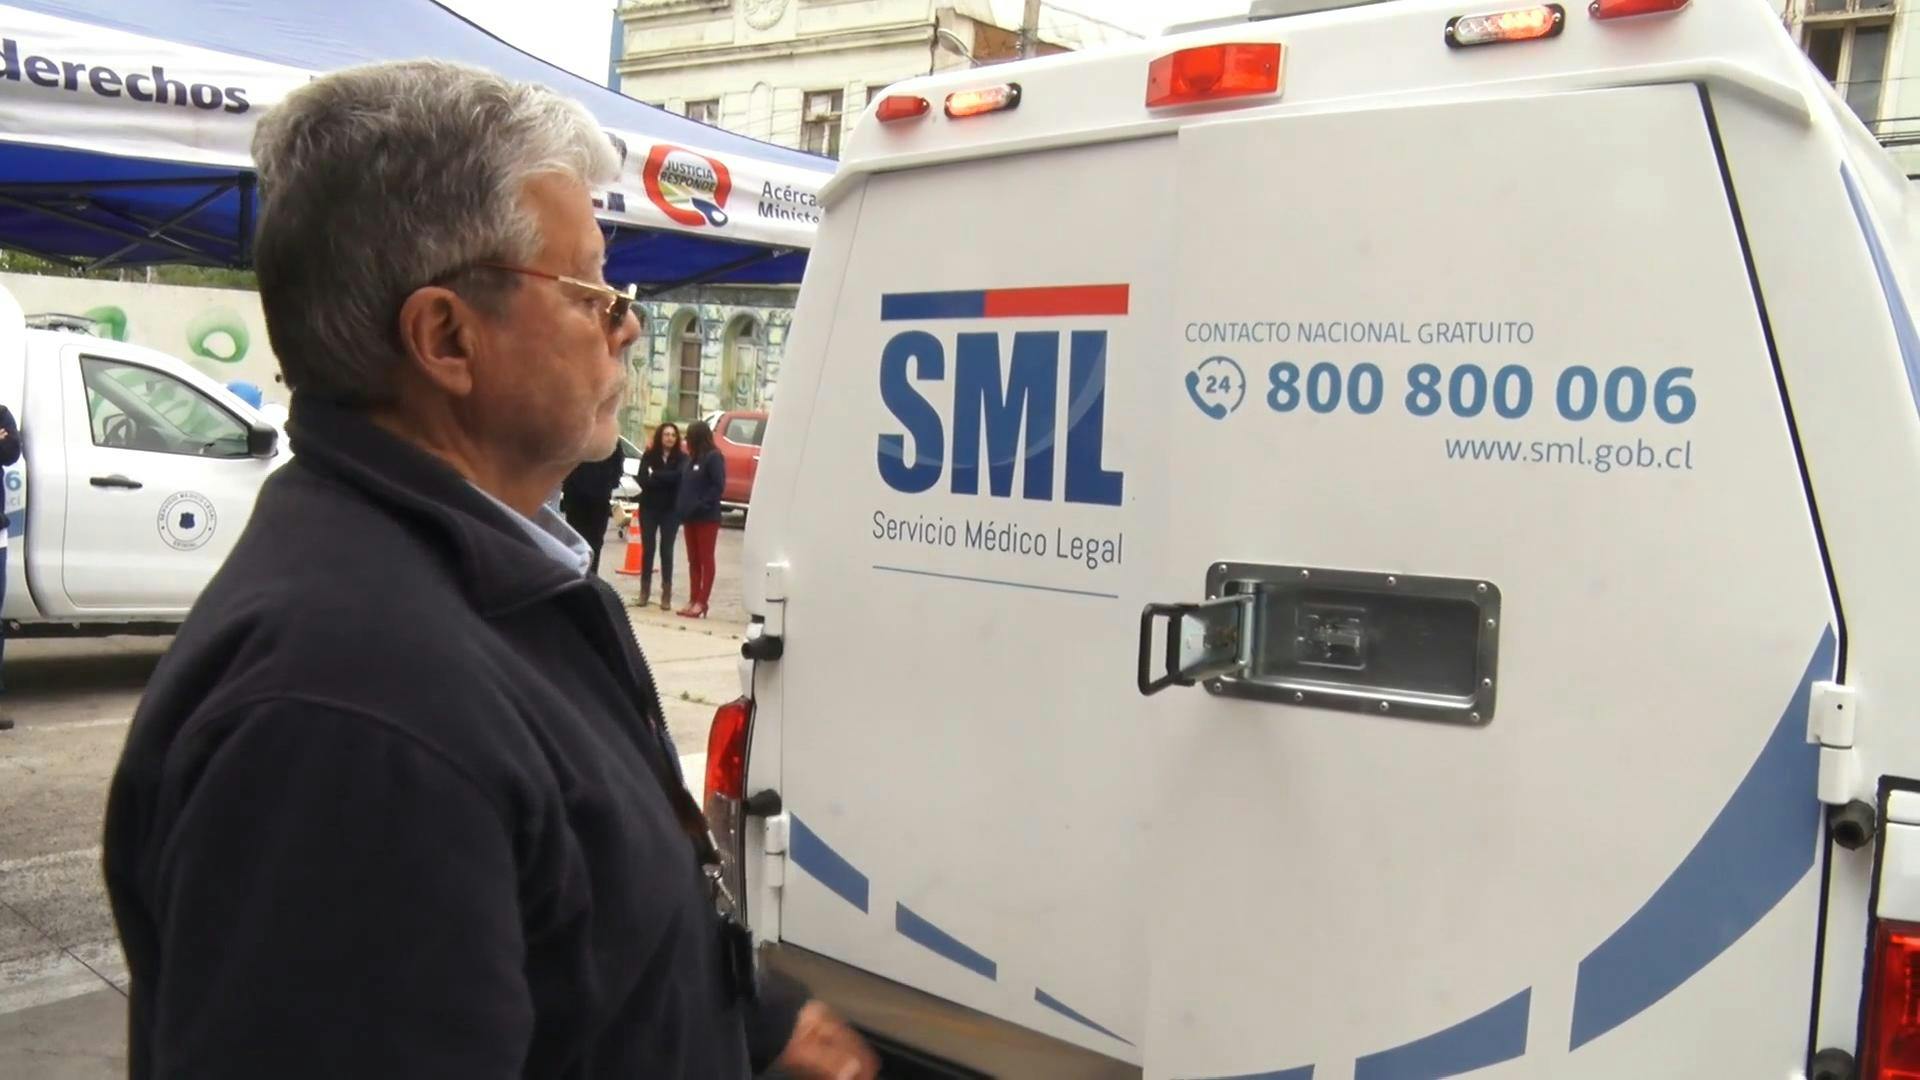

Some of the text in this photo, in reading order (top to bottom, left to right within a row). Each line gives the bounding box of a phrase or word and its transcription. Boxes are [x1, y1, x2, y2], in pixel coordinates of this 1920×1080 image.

[660, 171, 717, 193] RESPONDE
[666, 160, 714, 180] JUSTICIA
[761, 181, 821, 208] Acérca
[1184, 321, 1534, 344] CONTACTO NACIONAL GRATUITO
[1205, 375, 1232, 394] 24
[1266, 361, 1697, 425] 800 800 006
[877, 329, 1124, 507] SML
[1445, 437, 1694, 473] www.sml.gob.cl
[872, 509, 1123, 570] Servicio Médico Legal
